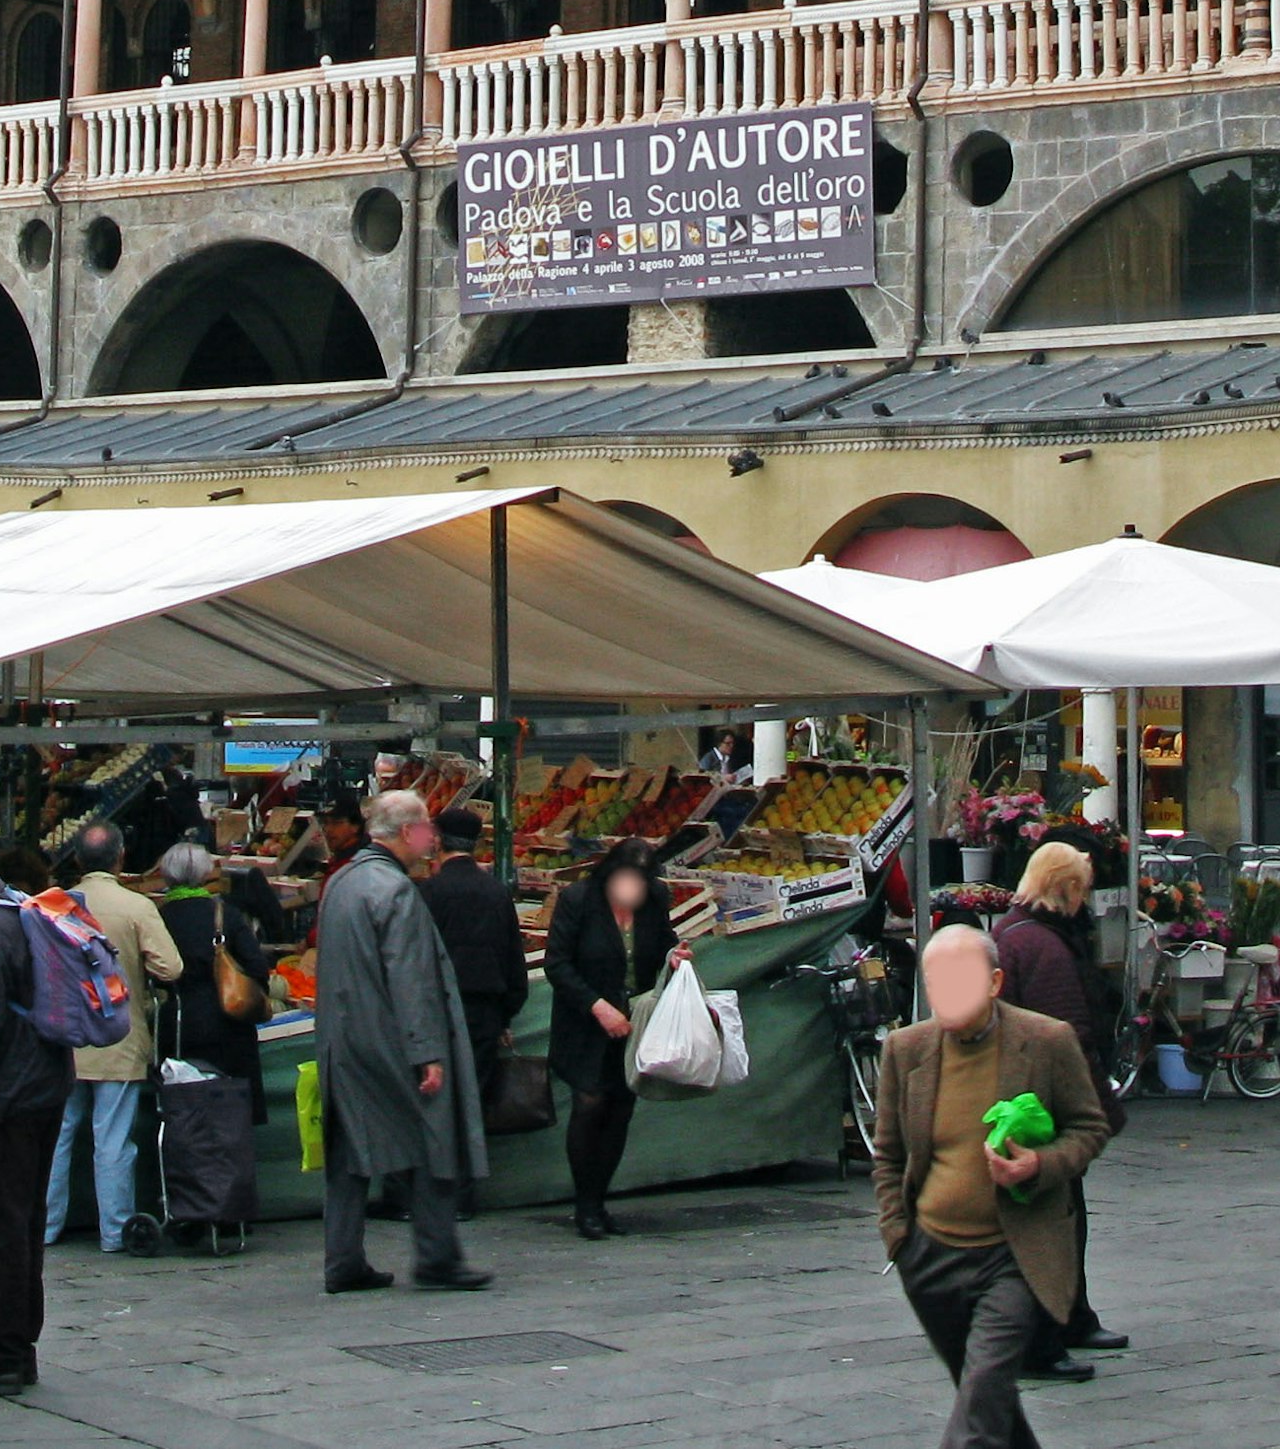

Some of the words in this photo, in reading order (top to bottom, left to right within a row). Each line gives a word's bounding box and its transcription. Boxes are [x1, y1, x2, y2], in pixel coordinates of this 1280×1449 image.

[464, 140, 625, 194] GIOIELLI
[649, 114, 865, 175] D'AUTORE
[465, 192, 562, 233] Padova
[577, 201, 593, 222] e
[609, 190, 633, 220] la
[647, 185, 742, 217] Scuola
[757, 168, 865, 207] dell'oro
[466, 270, 506, 285] Palazzo
[508, 265, 535, 281] della
[537, 263, 578, 281] Ragione
[582, 263, 590, 275] 4
[594, 260, 624, 276] aprile
[628, 258, 636, 272] 3
[640, 259, 675, 273] agosto
[678, 253, 706, 267] 2008
[859, 814, 893, 854] Melinda
[871, 827, 905, 868] Melinda
[779, 877, 820, 898] Melinda
[783, 901, 824, 921] Melinda
